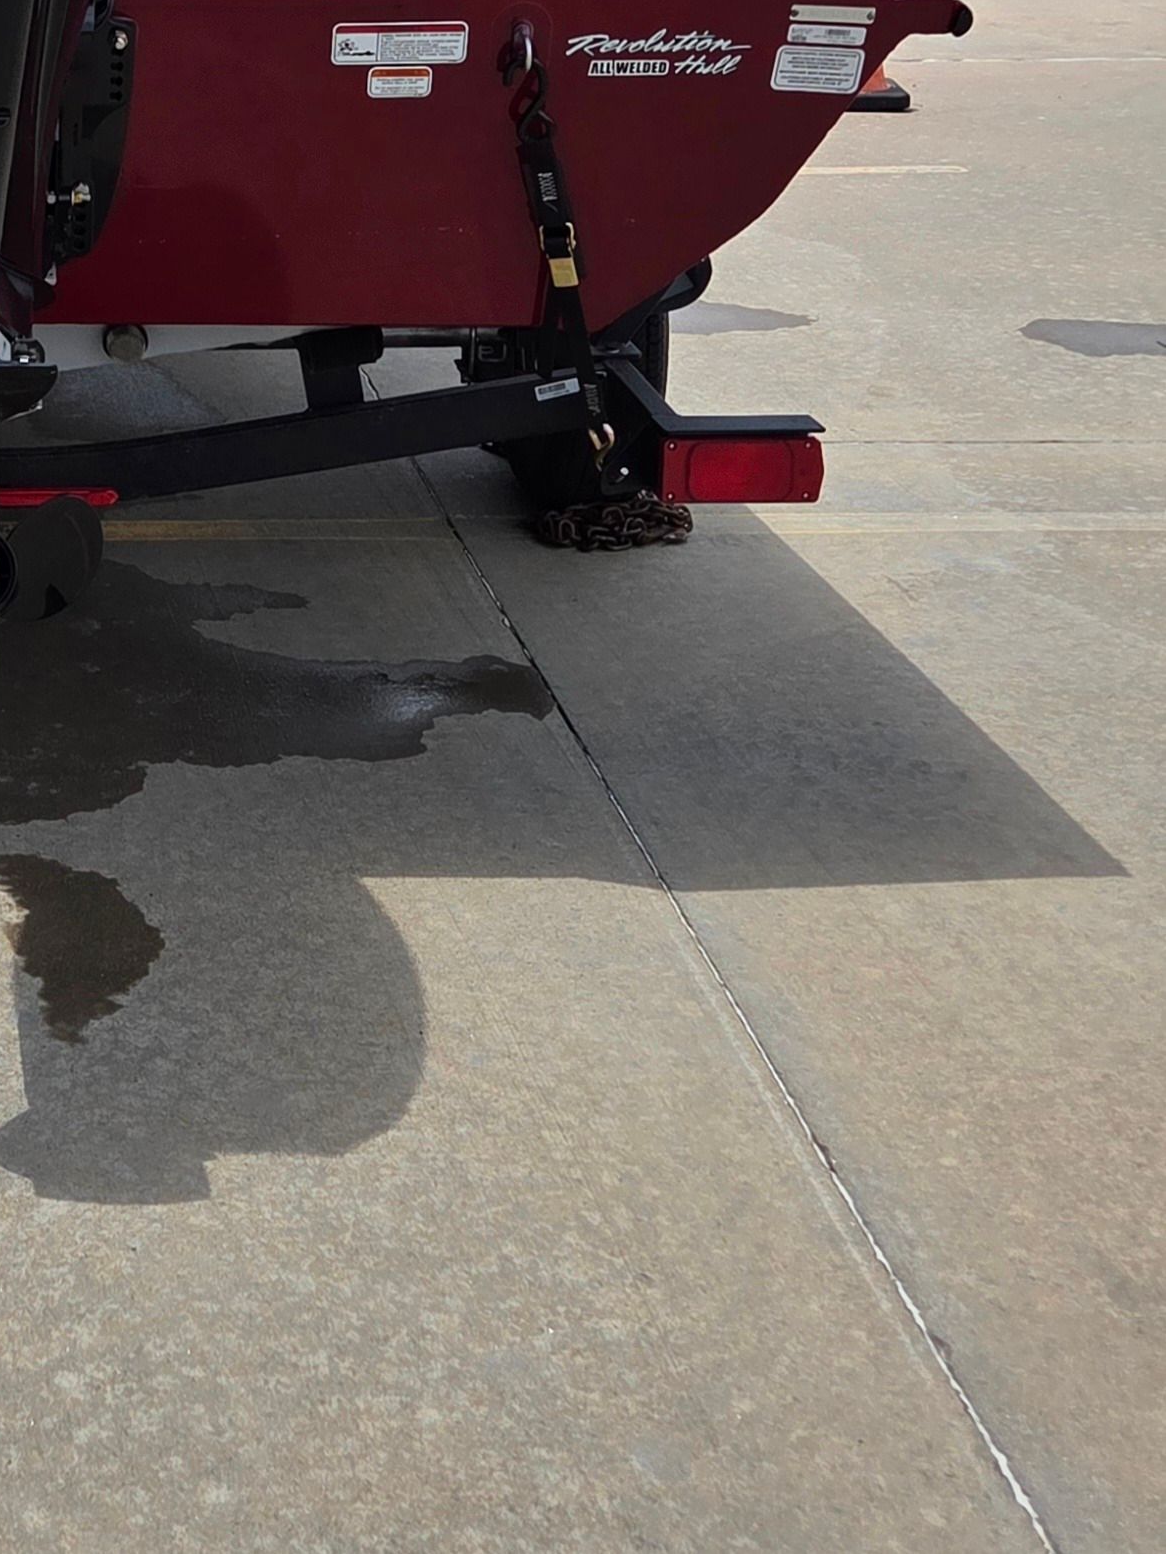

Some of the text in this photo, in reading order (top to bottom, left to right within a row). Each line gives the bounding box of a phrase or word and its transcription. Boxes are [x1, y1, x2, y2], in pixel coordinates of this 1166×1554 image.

[565, 28, 752, 56] Revolution
[590, 55, 742, 76] ALL WELDED Hull
